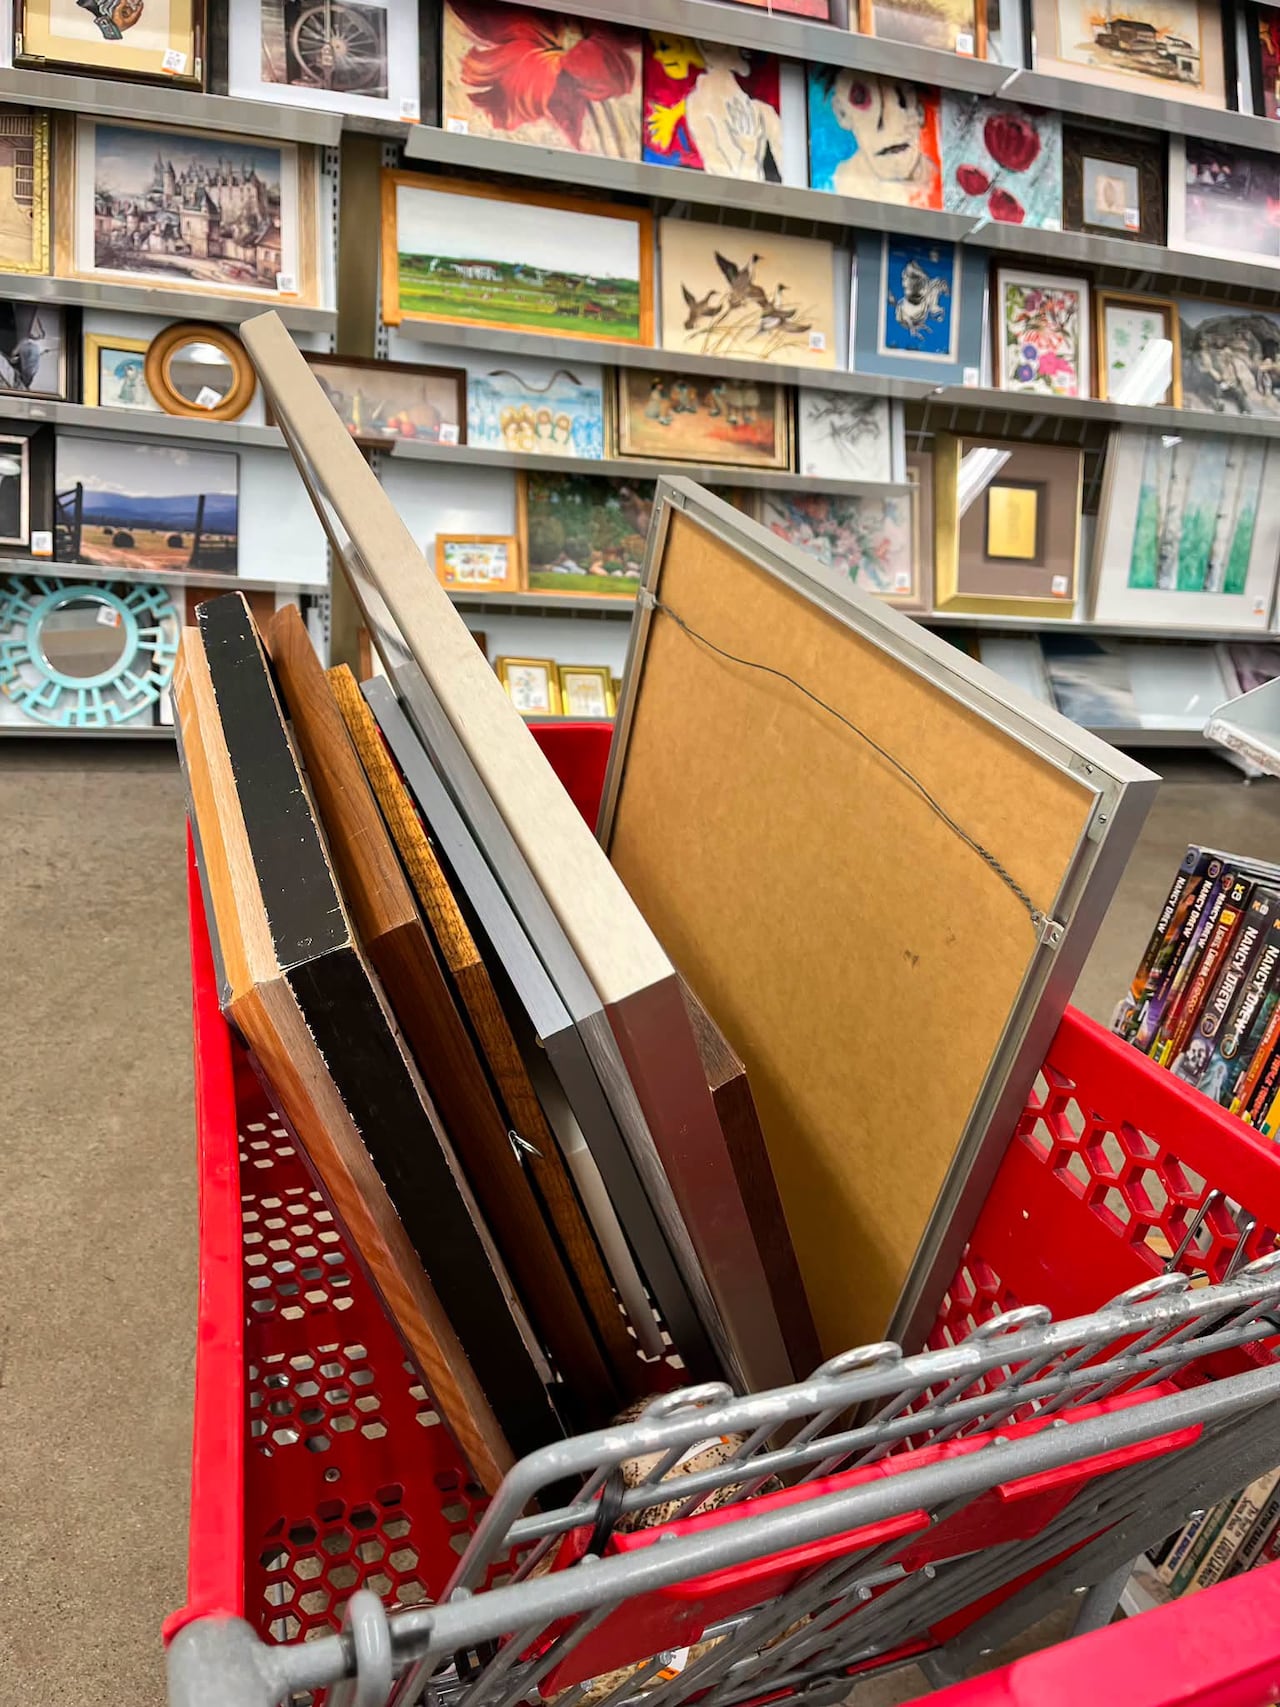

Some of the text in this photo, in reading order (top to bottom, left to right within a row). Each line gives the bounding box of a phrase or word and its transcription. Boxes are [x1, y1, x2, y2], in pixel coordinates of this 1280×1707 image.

[1156, 876, 1186, 933] NANCY DREW
[1182, 879, 1213, 938] NANCY DREW
[1196, 892, 1226, 948] NANCY DREW
[1230, 925, 1259, 971] NANCY
[1250, 943, 1280, 991] NANCY
[1212, 971, 1239, 1014] DREW
[1231, 992, 1260, 1035] DREW
